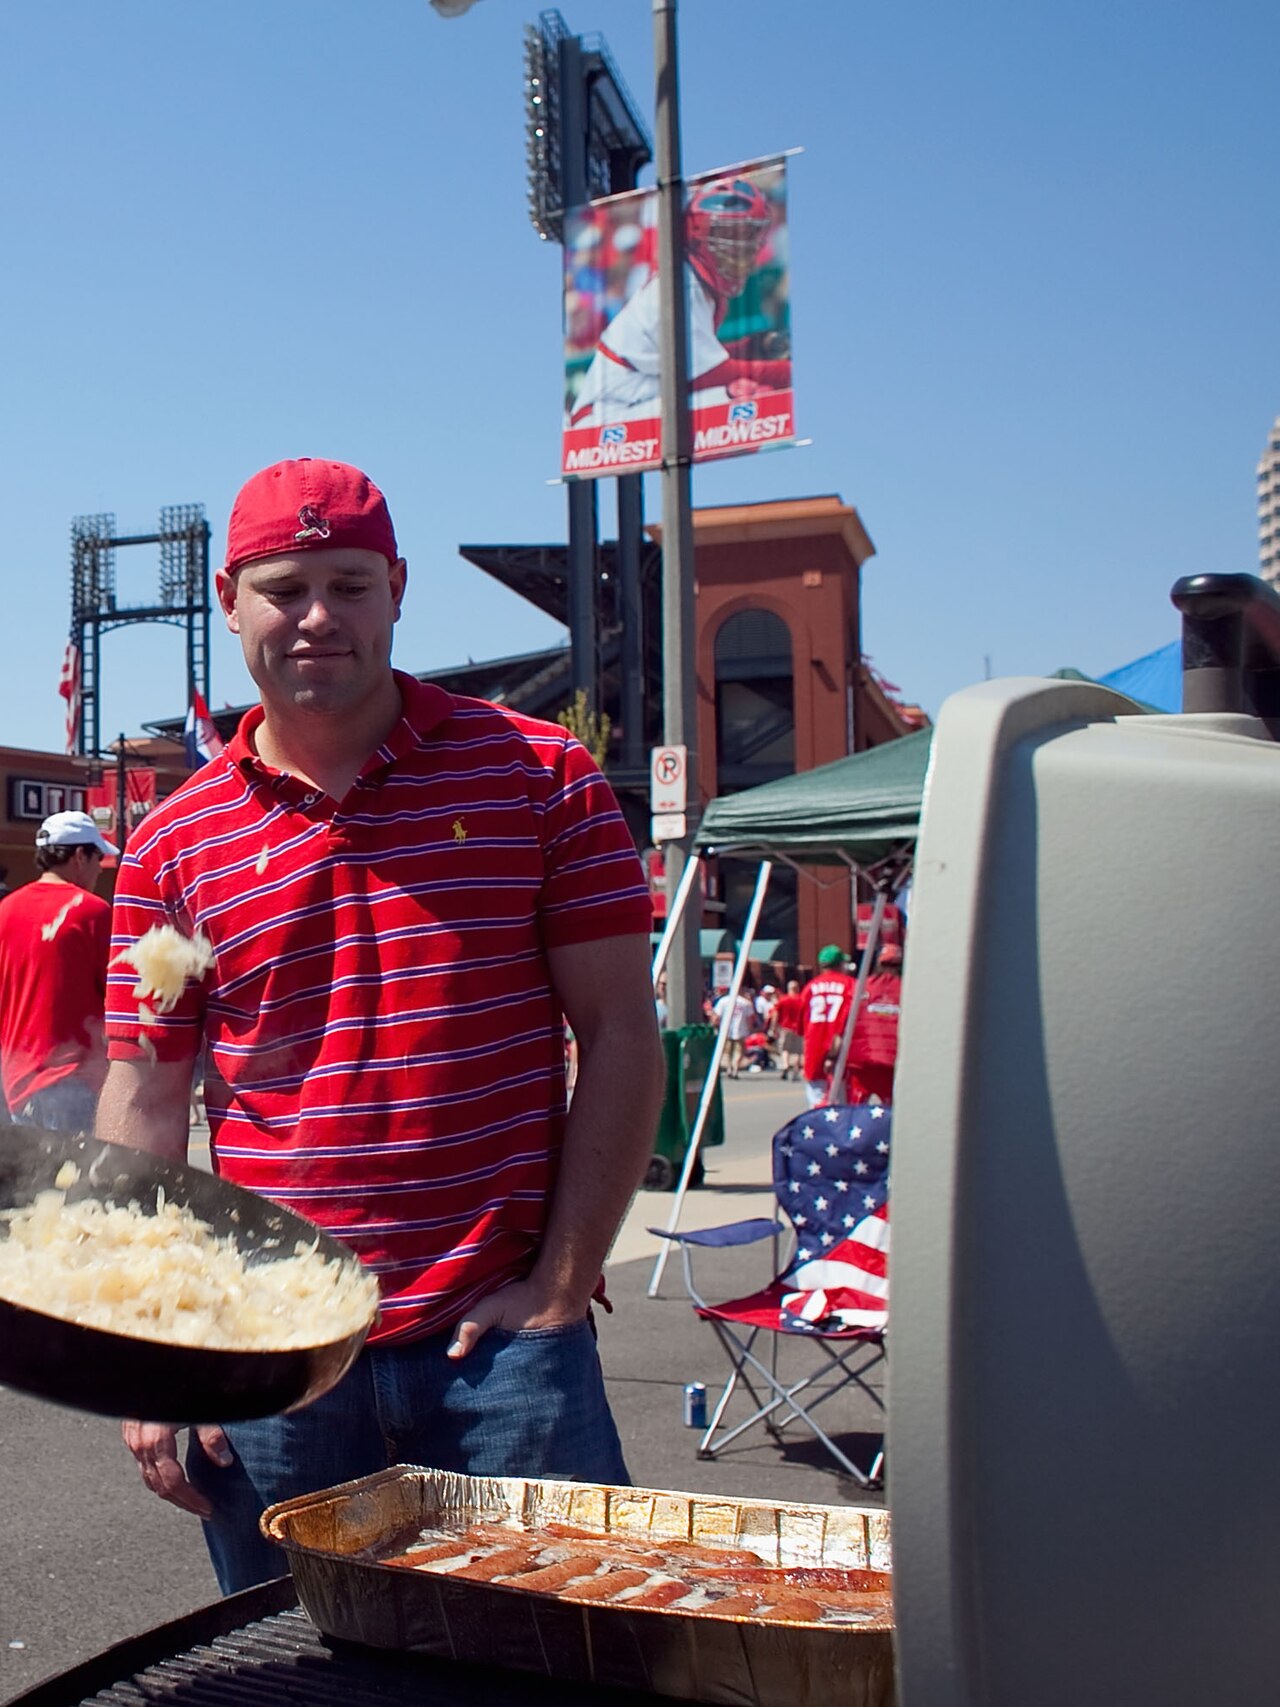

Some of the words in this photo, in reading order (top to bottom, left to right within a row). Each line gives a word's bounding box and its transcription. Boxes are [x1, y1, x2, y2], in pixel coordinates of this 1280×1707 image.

[694, 413, 791, 450] MIDWEST
[565, 438, 659, 470] MIDWEST
[809, 995, 844, 1024] 27
